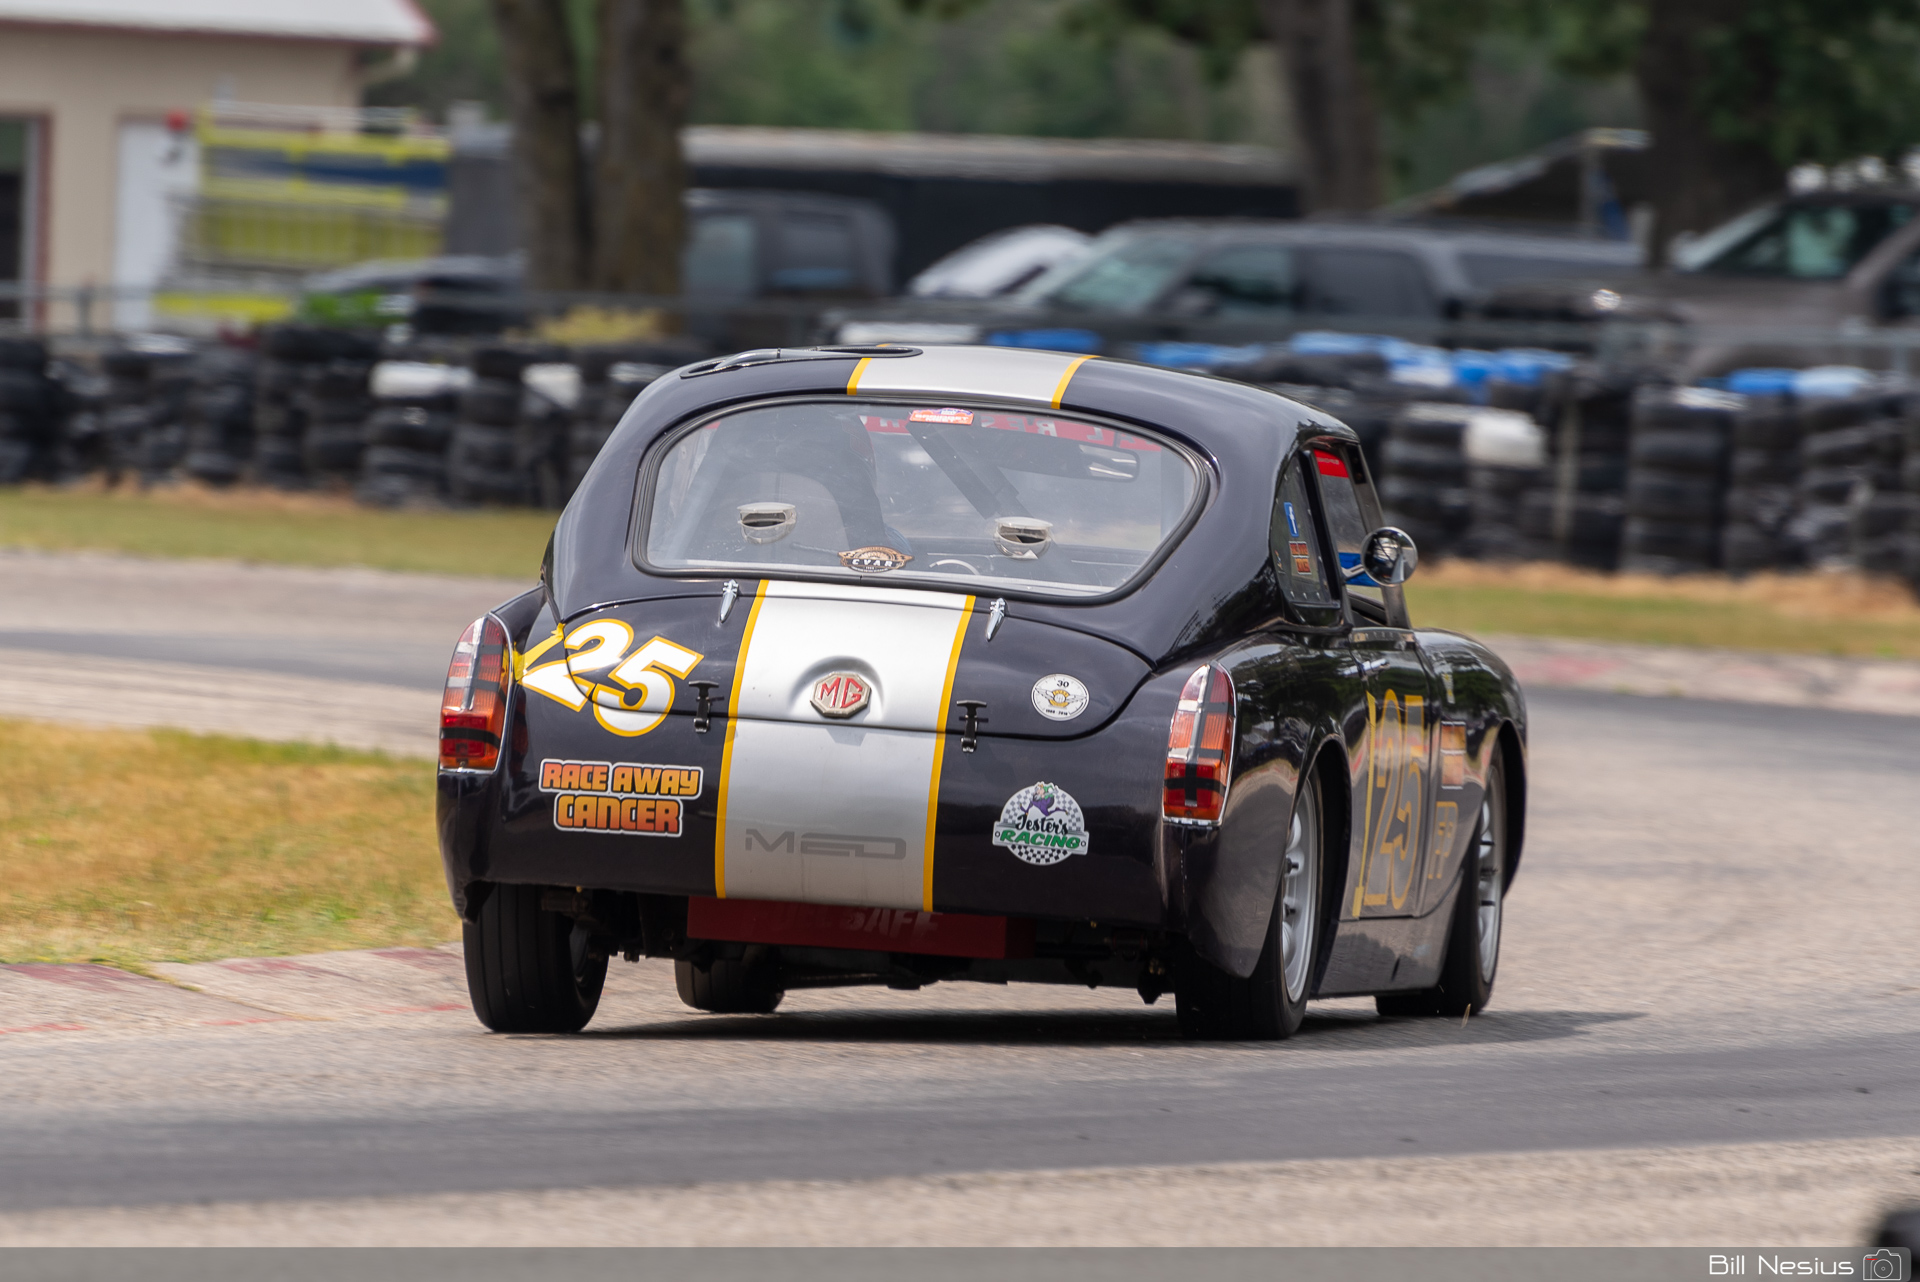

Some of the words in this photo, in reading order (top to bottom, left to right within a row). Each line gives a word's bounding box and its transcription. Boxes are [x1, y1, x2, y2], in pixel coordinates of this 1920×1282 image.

[818, 676, 863, 709] MG
[1056, 680, 1069, 688] 30
[541, 762, 609, 791] RACE
[611, 765, 700, 796] AWAY
[556, 794, 681, 834] CANCER
[1015, 814, 1069, 835] Jester's
[744, 827, 907, 861] MED
[1000, 829, 1081, 849] RACING
[836, 907, 944, 940] SAFE
